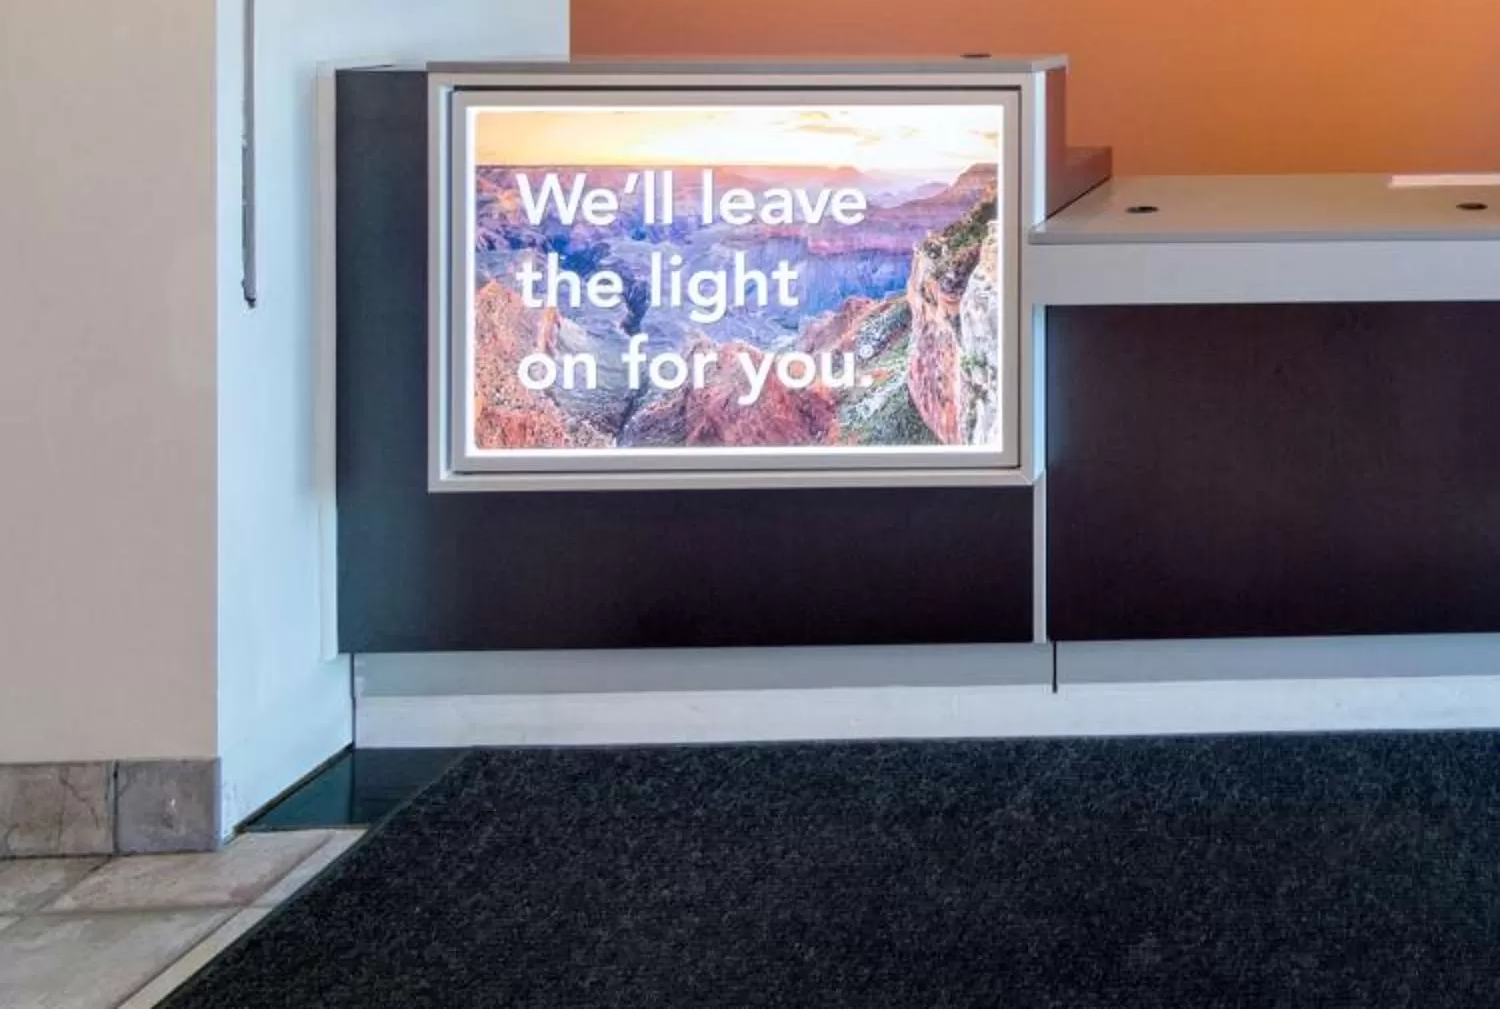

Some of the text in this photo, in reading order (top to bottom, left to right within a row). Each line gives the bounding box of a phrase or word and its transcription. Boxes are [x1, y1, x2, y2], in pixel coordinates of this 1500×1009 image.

[515, 169, 868, 226] We'll leave
[515, 252, 799, 323] the light
[516, 350, 598, 391] on
[622, 333, 719, 391] for
